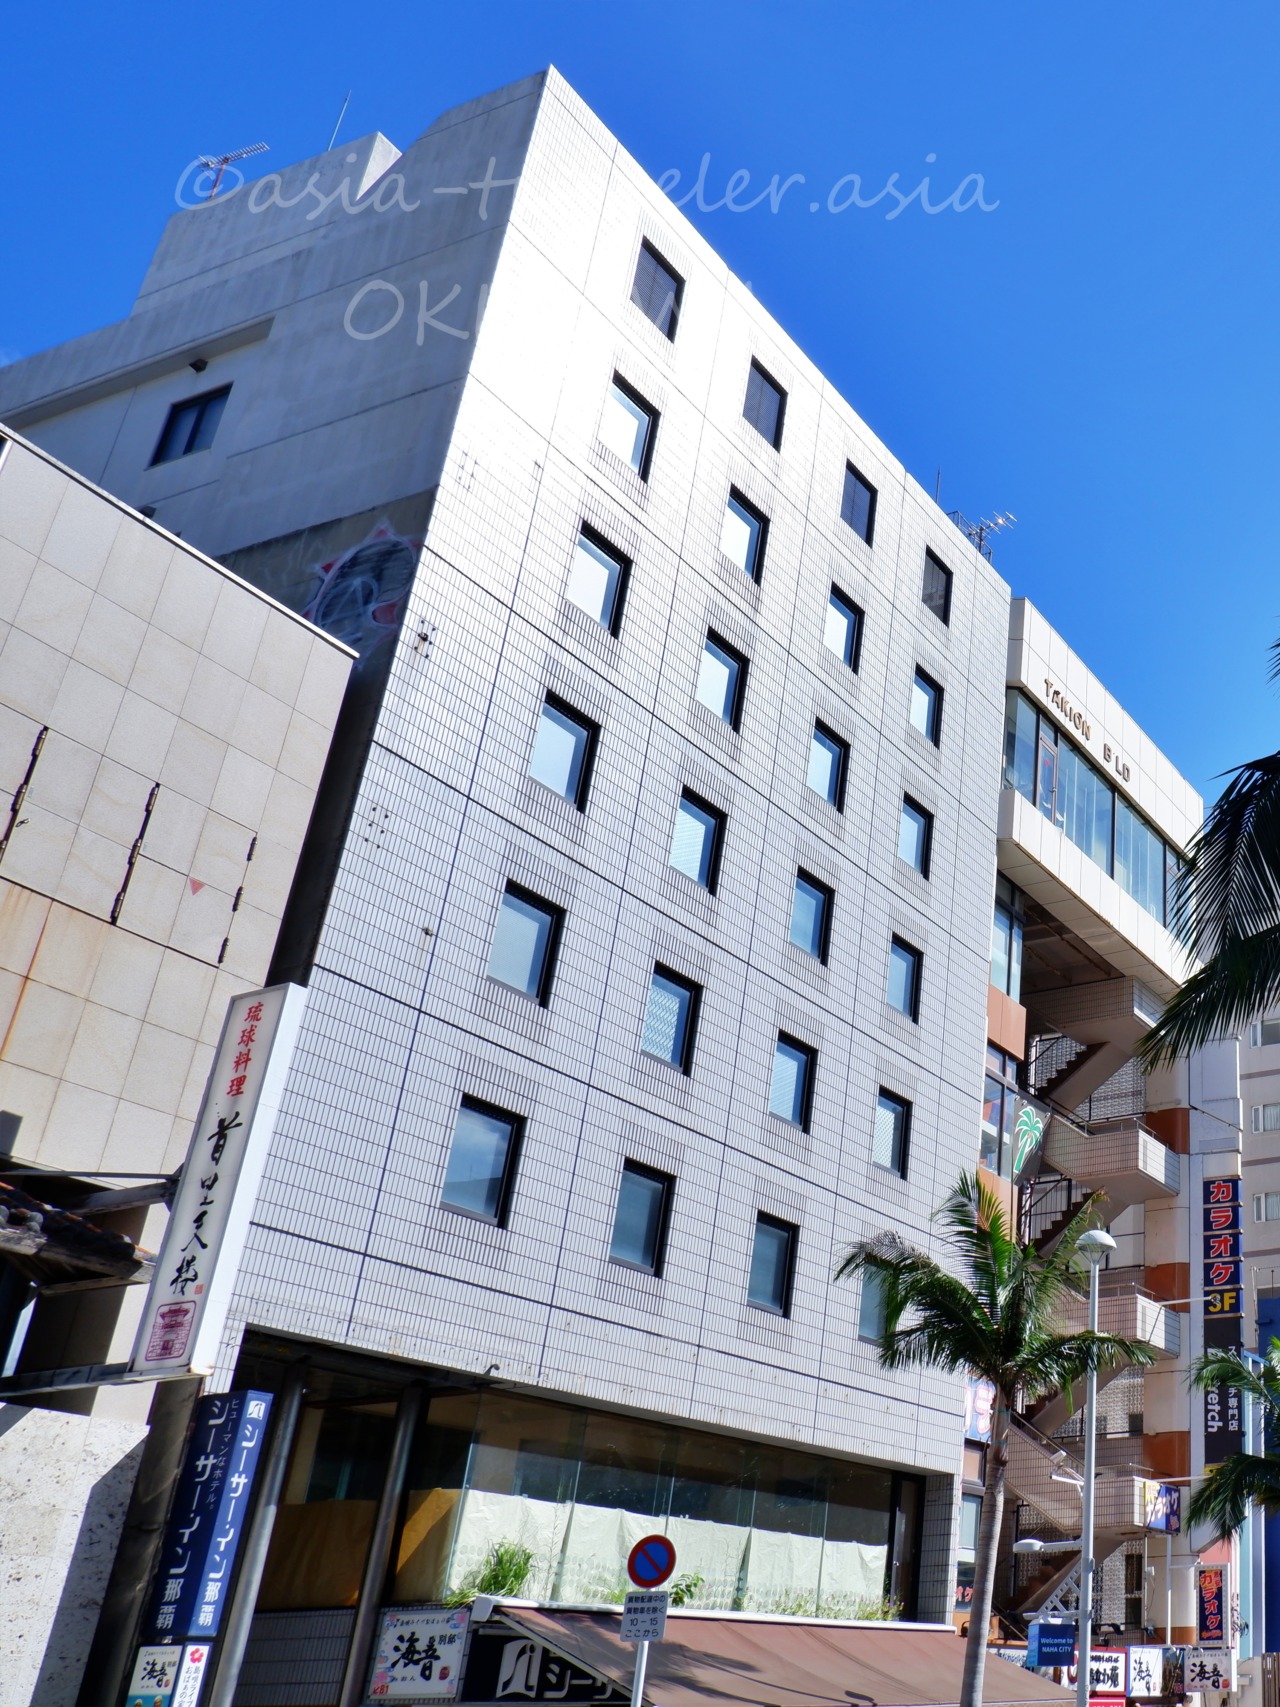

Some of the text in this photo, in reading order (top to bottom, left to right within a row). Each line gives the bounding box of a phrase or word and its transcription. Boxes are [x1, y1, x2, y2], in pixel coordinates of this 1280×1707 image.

[226, 1002, 265, 1097] 琉球料理
[1209, 1181, 1234, 1286] カラオケ
[1208, 1291, 1237, 1313] 3F
[155, 1400, 230, 1630] シーサー・イン那覇
[198, 1423, 260, 1627] シーサー・イン那覇
[625, 1628, 659, 1638] ここから
[1200, 1574, 1221, 1629] カラオケ
[1040, 1637, 1068, 1645] Welcome
